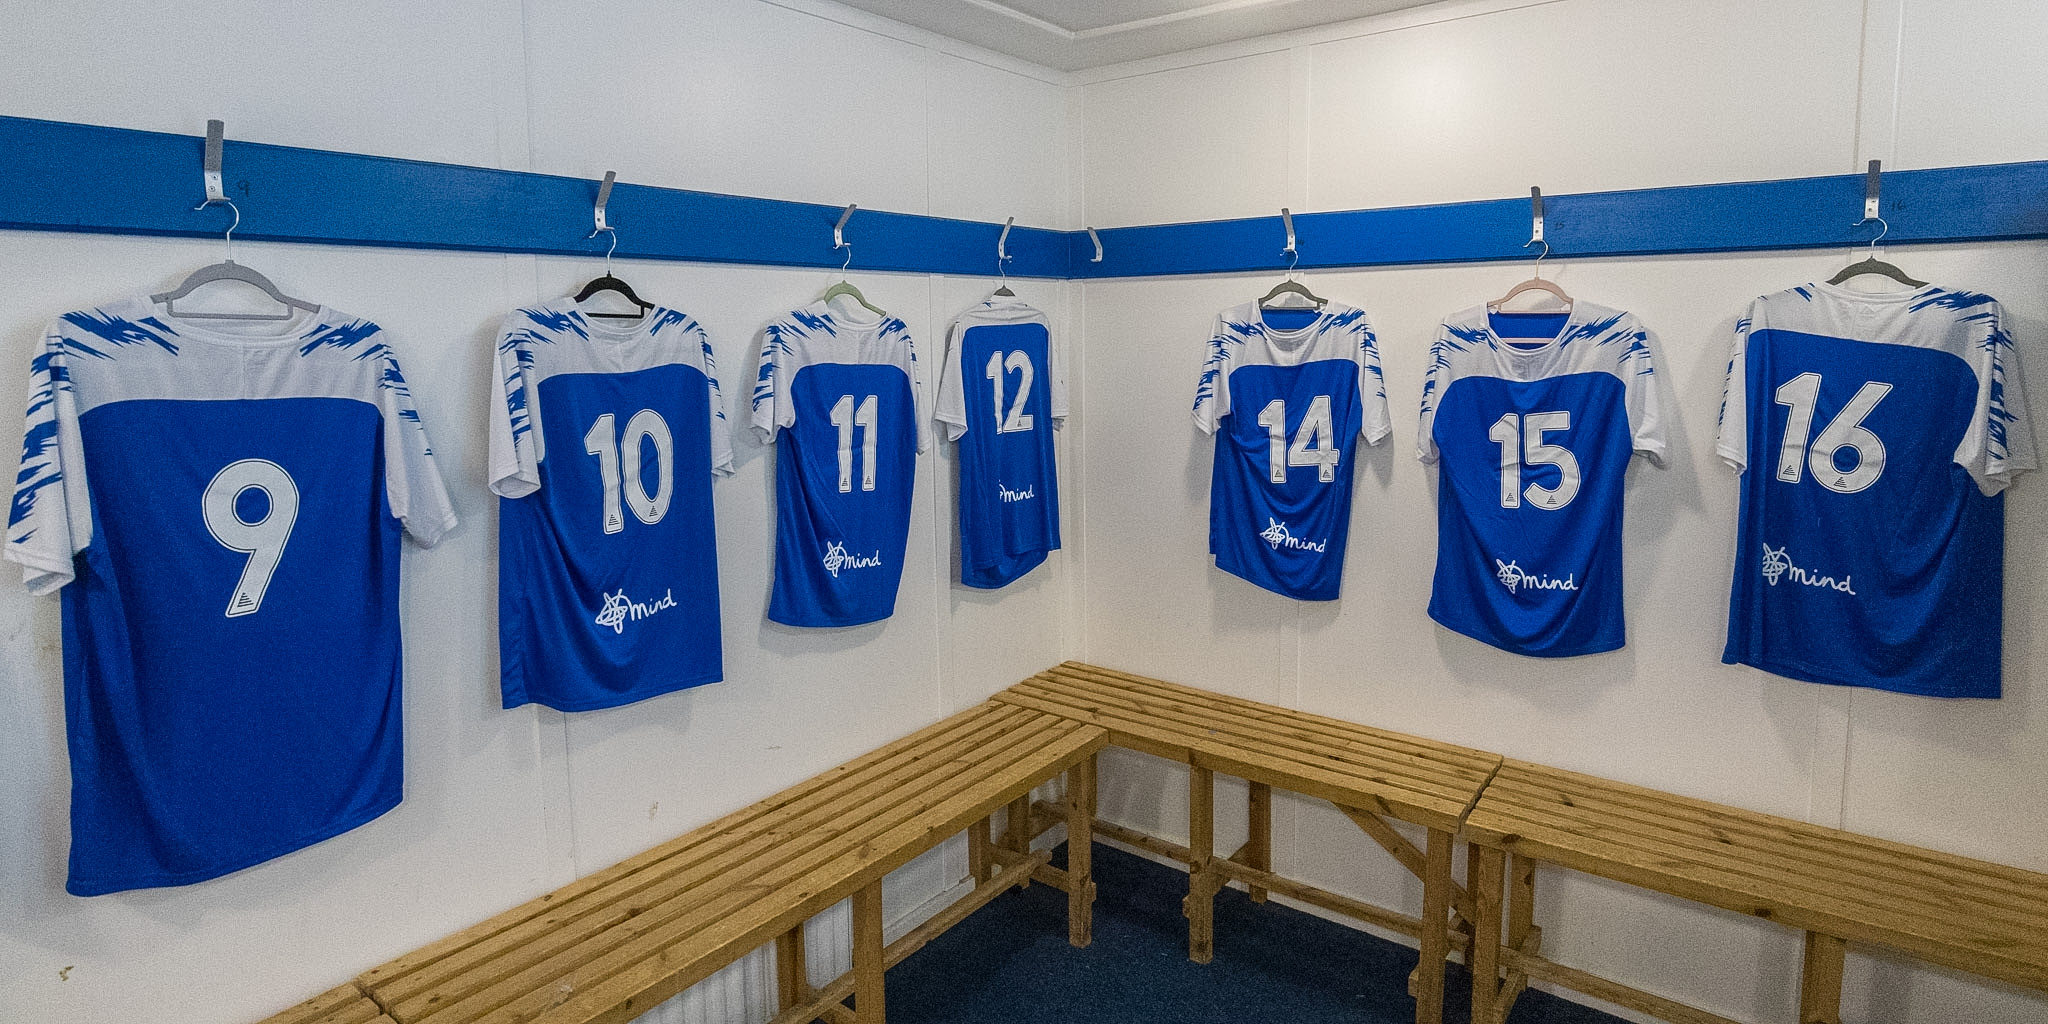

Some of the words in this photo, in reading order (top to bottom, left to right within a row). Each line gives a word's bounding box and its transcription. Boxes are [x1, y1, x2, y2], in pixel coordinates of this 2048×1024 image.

[986, 349, 1034, 435] 12
[1775, 371, 1893, 494] 16
[584, 408, 673, 534] 10
[829, 394, 878, 493] 11
[1257, 395, 1341, 484] 14
[1489, 411, 1582, 511] 15
[1004, 484, 1035, 502] mind
[201, 458, 300, 618] 9
[844, 550, 882, 570] mind
[1285, 534, 1327, 553] mind
[1789, 564, 1856, 596] mind
[631, 588, 677, 621] mind
[1523, 572, 1579, 591] mind
